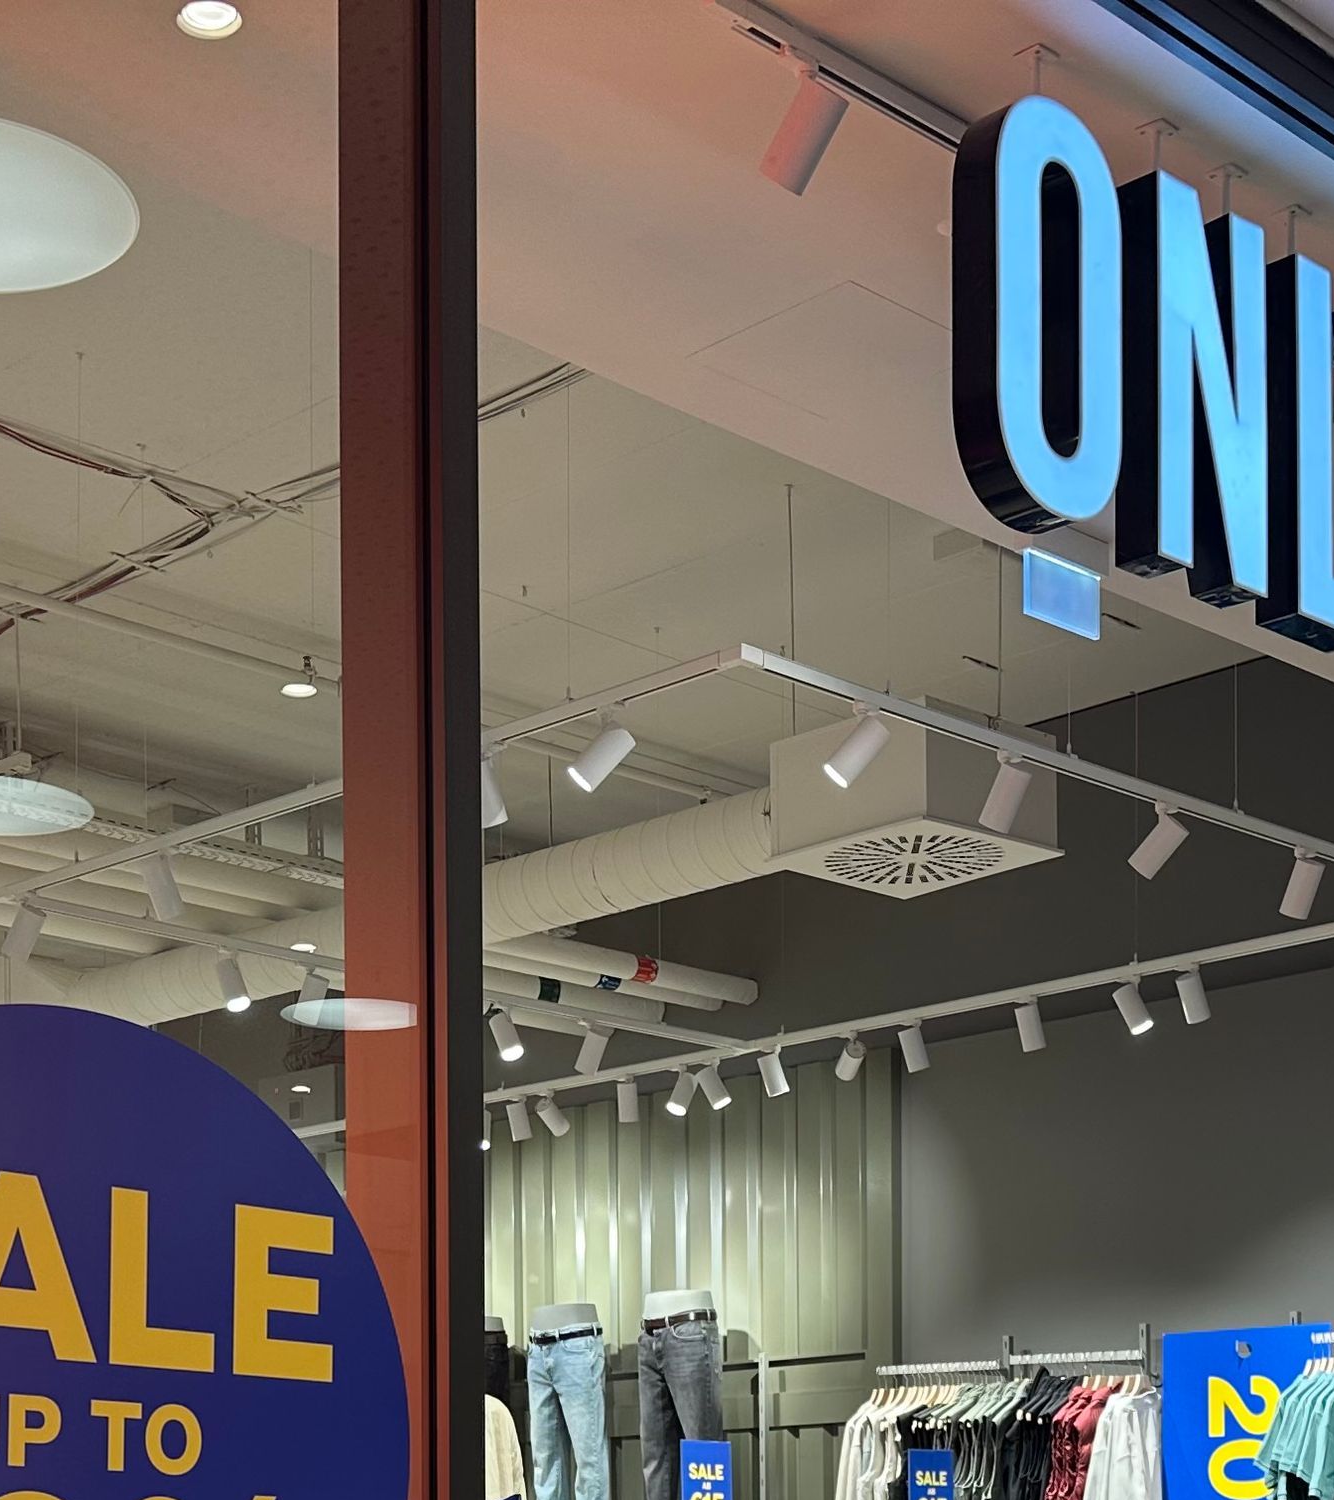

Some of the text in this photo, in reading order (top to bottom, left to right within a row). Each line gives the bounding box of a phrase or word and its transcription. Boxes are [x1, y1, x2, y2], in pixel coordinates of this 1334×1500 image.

[91, 1400, 202, 1475] TO
[688, 1462, 724, 1481] SALE
[915, 1470, 948, 1487] SALE
